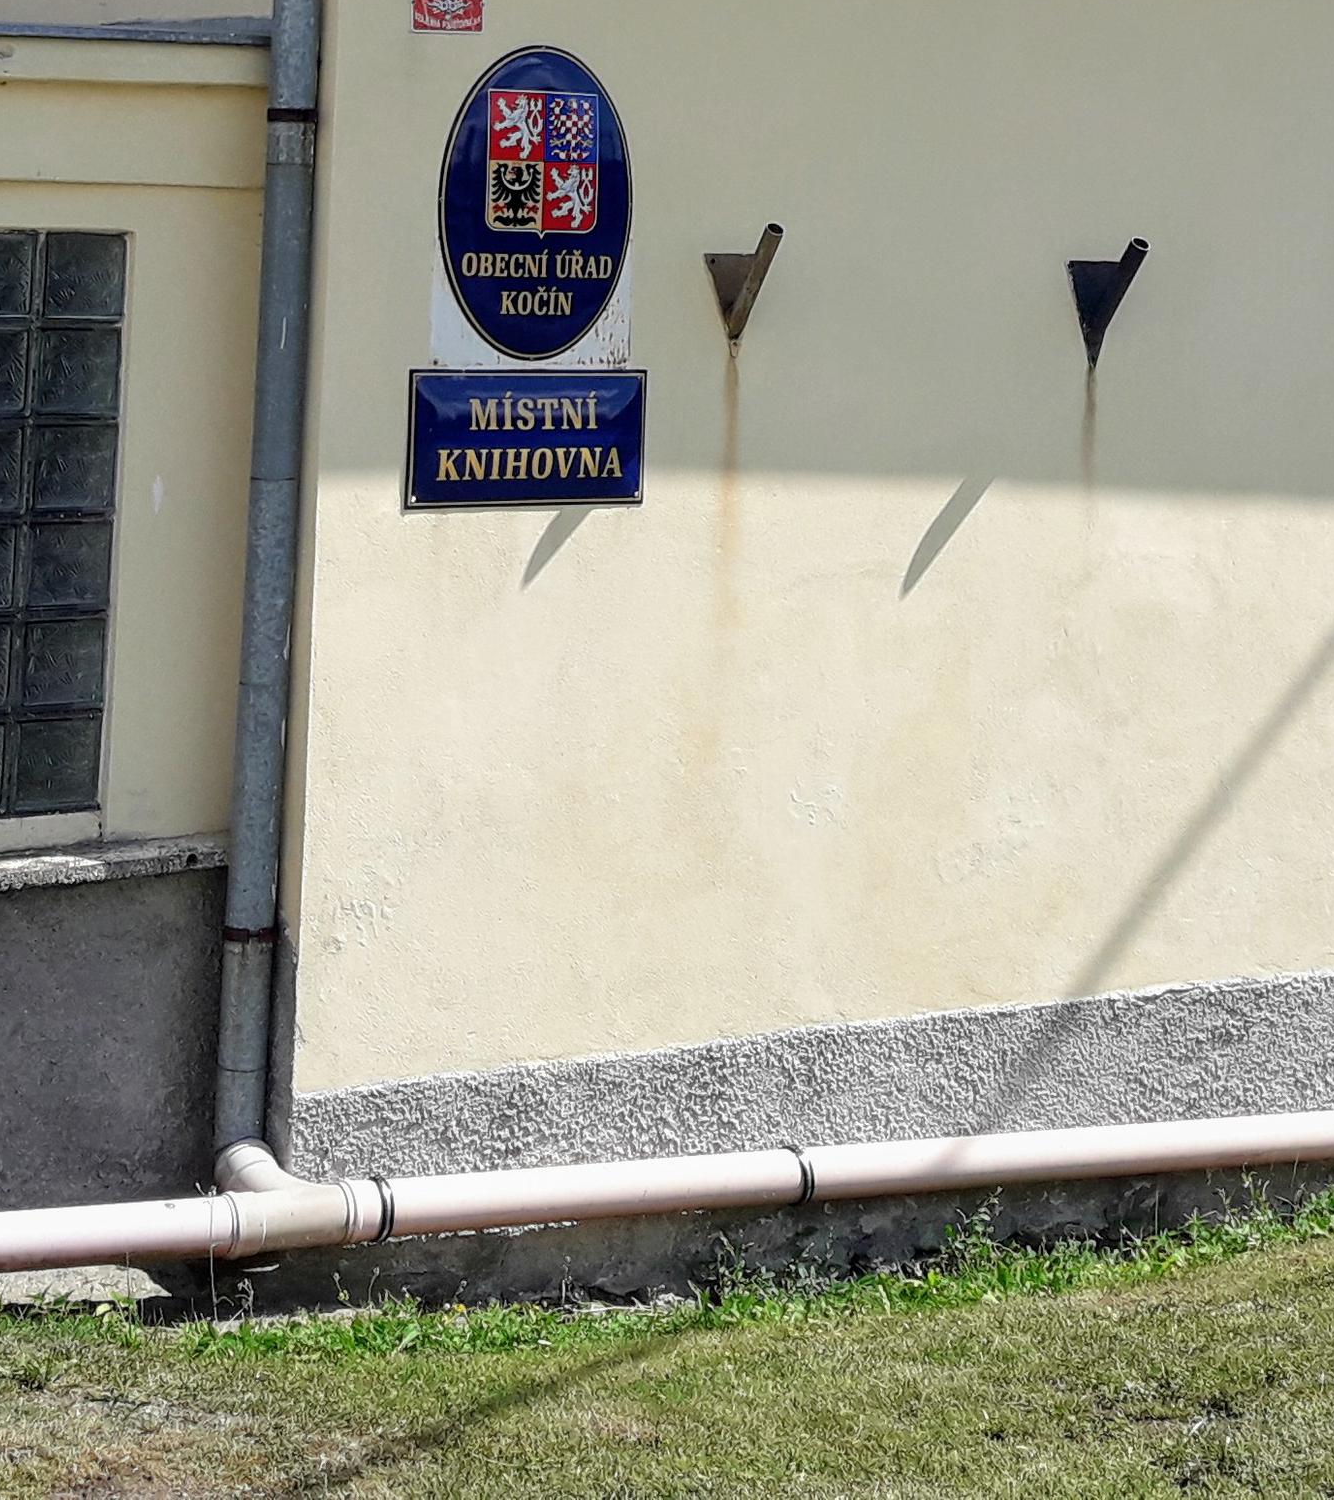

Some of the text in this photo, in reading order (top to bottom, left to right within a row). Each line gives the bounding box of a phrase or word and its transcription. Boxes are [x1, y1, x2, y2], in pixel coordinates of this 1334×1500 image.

[461, 249, 613, 279] OBECNÍ ÚŘAD
[500, 286, 573, 316] KOČÍN
[469, 391, 599, 431] MÍSTNÍ
[435, 447, 623, 482] KNIHOVNA
